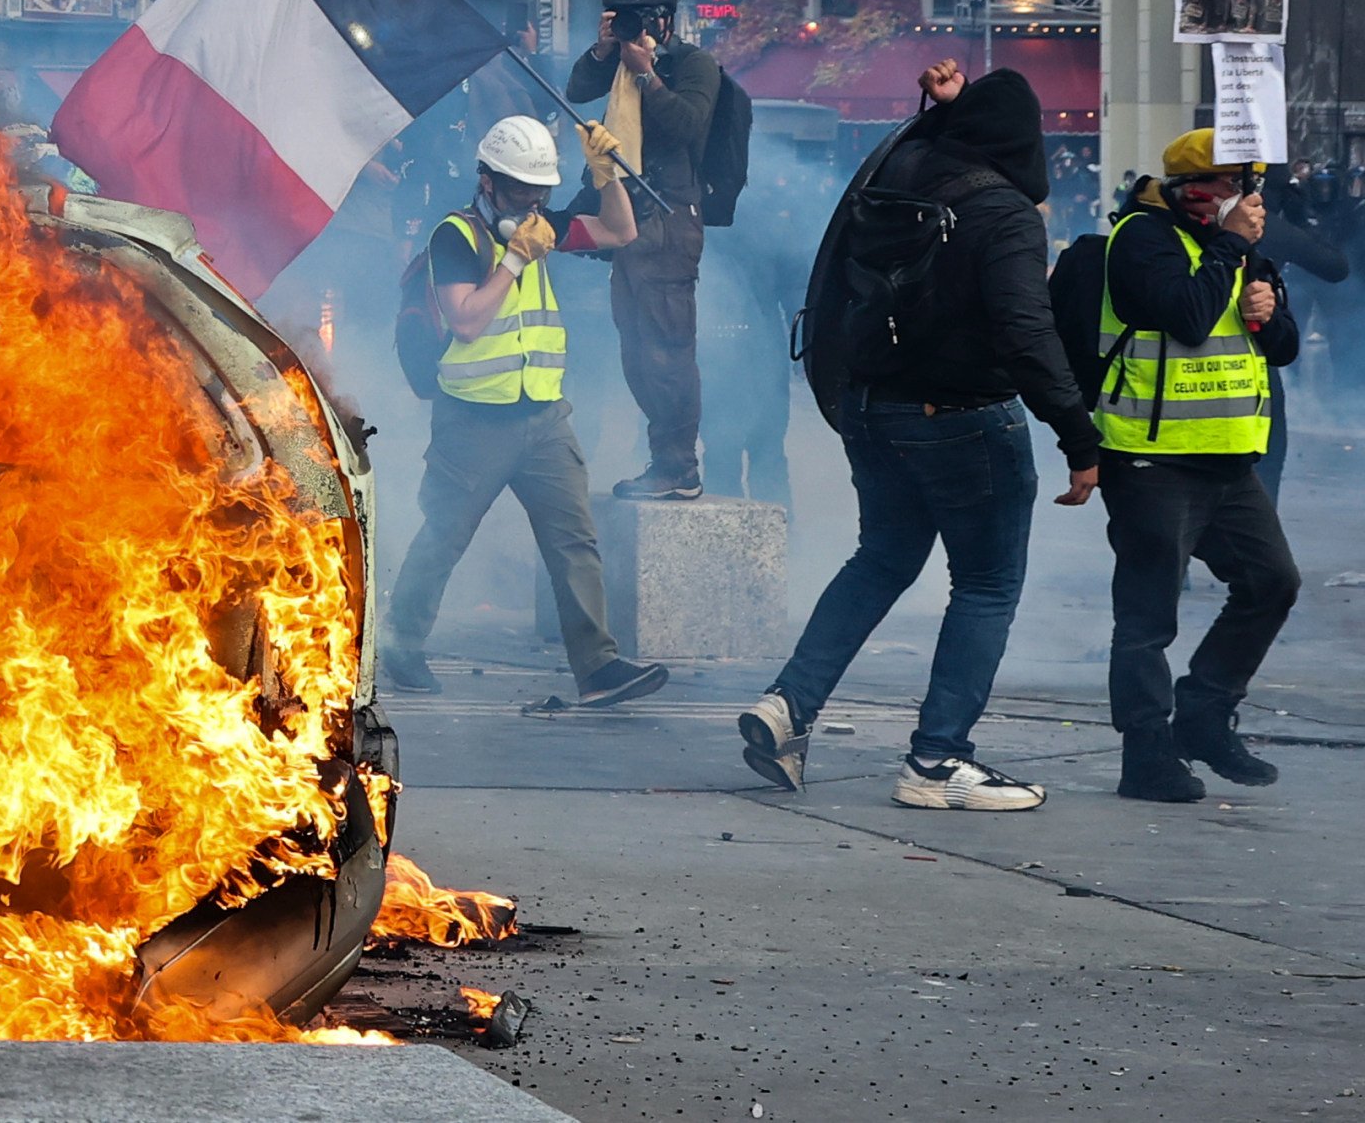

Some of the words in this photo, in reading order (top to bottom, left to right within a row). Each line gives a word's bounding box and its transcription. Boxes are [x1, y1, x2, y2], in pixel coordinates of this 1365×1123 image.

[696, 4, 740, 18] TEMPL
[1181, 362, 1205, 373] CELUI
[1207, 361, 1221, 372] QUI
[1173, 382, 1198, 393] CELUI
[1199, 381, 1214, 392] QUI
[1216, 380, 1228, 391] NE
